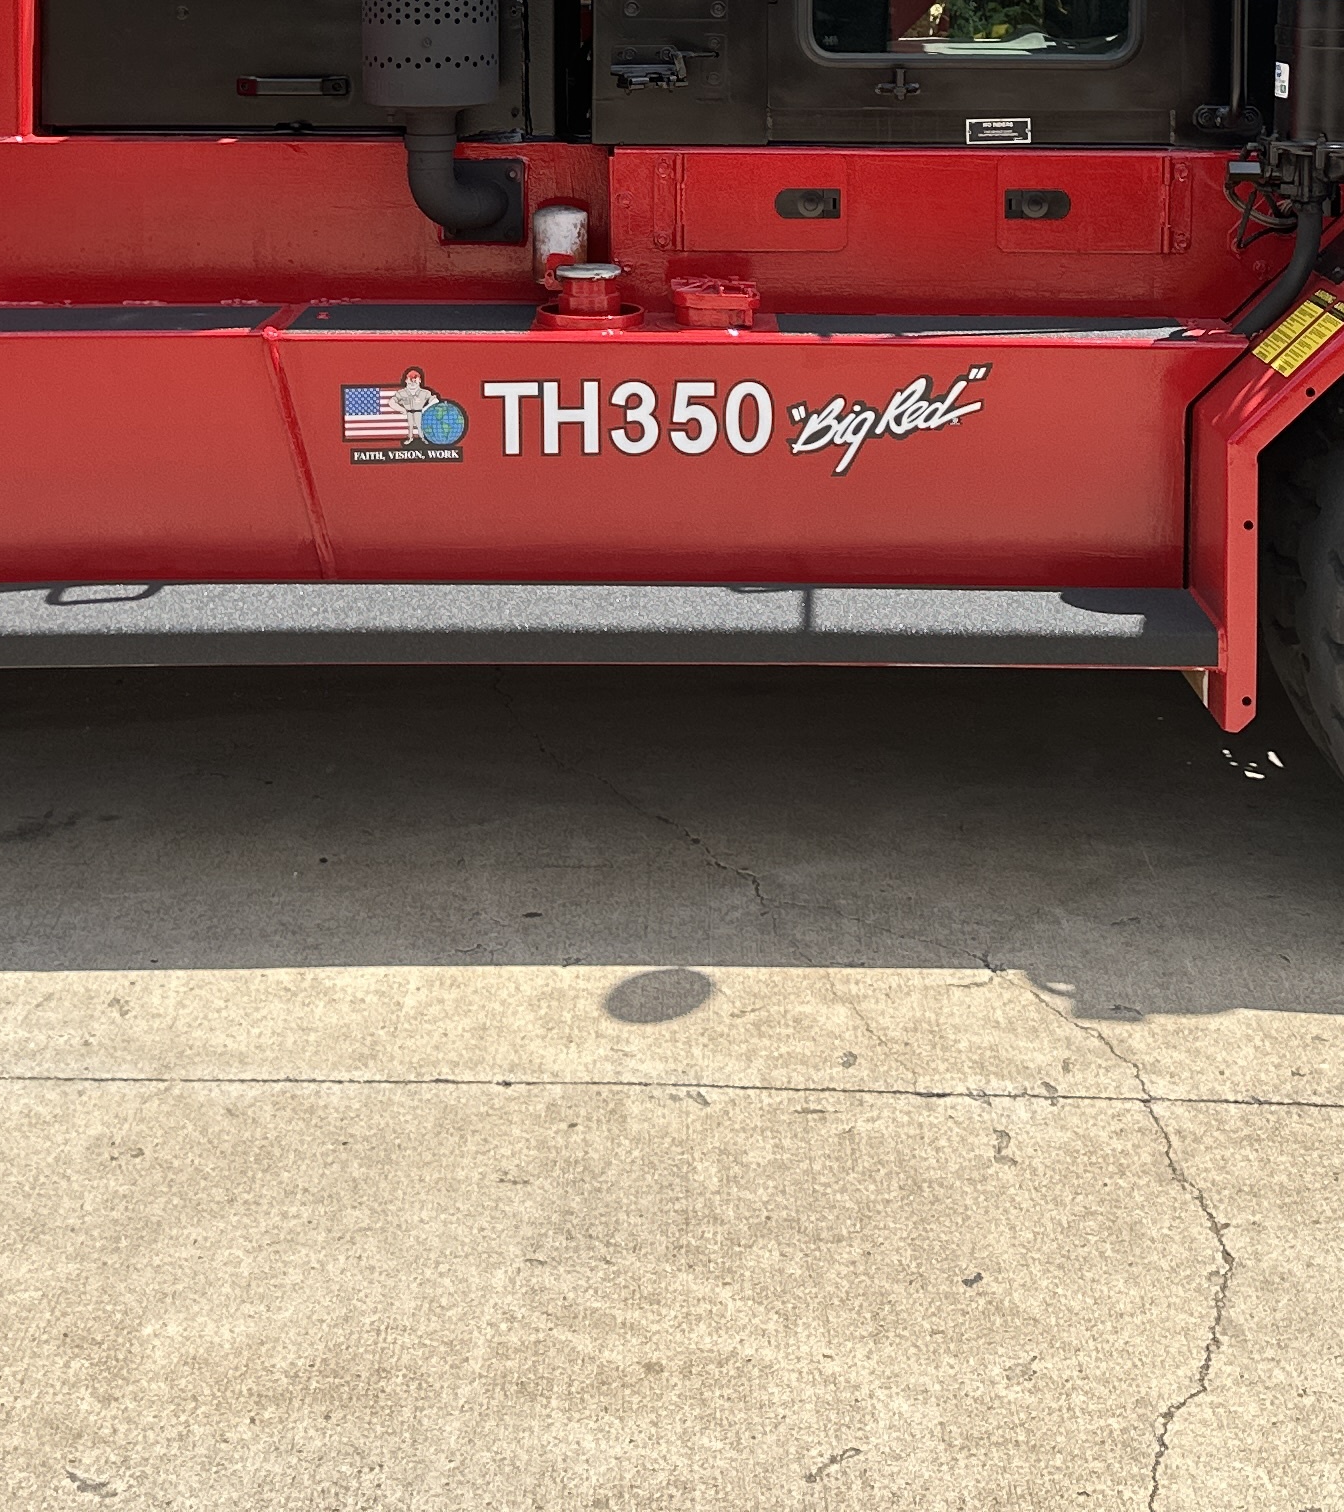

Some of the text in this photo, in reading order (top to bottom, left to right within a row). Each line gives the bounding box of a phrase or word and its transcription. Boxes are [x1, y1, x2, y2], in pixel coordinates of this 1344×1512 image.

[483, 367, 987, 473] TH350 "Big Red"
[353, 449, 459, 461] FAITH, VISION, WORK
